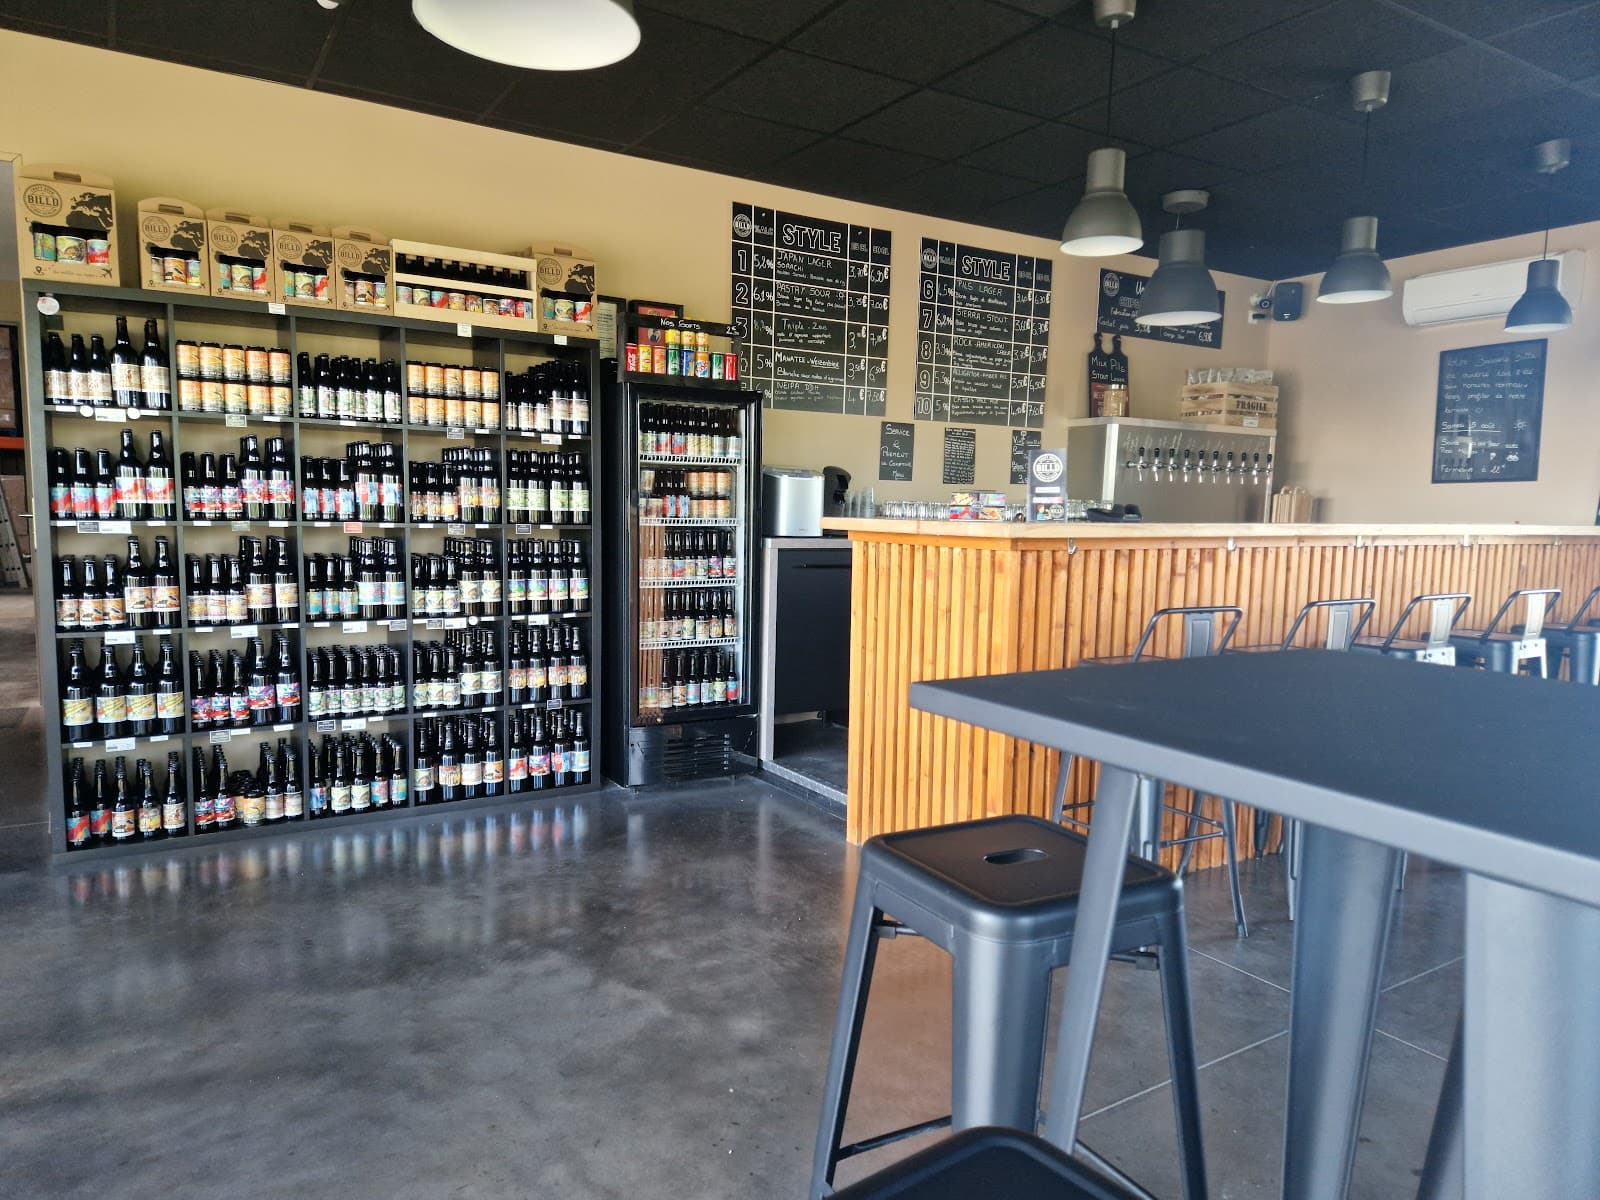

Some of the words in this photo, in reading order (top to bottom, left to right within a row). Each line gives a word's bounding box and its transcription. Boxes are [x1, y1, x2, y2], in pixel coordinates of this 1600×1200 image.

[27, 194, 59, 207] BILLD
[144, 224, 168, 234] BILLD
[782, 224, 842, 254] STYLE
[738, 250, 746, 272] 1
[777, 250, 804, 264] JAPAN
[808, 256, 832, 268] LAGER
[777, 261, 804, 272] SORACHI
[962, 256, 1010, 280] STYLE
[736, 282, 748, 304] 2
[776, 282, 805, 294] PASTRY
[810, 287, 831, 298] SOUR
[924, 280, 934, 300] 6
[980, 286, 1002, 296] LAGER
[660, 318, 675, 328] Nos
[923, 308, 932, 328] 7
[956, 308, 982, 320] SIERRA
[987, 314, 1008, 323] STOUT
[736, 317, 748, 338] 3
[921, 340, 932, 360] 8
[776, 382, 800, 390] NEIPA
[920, 370, 930, 389] 9
[916, 396, 932, 415] 10
[1236, 400, 1267, 411] FRAGILE
